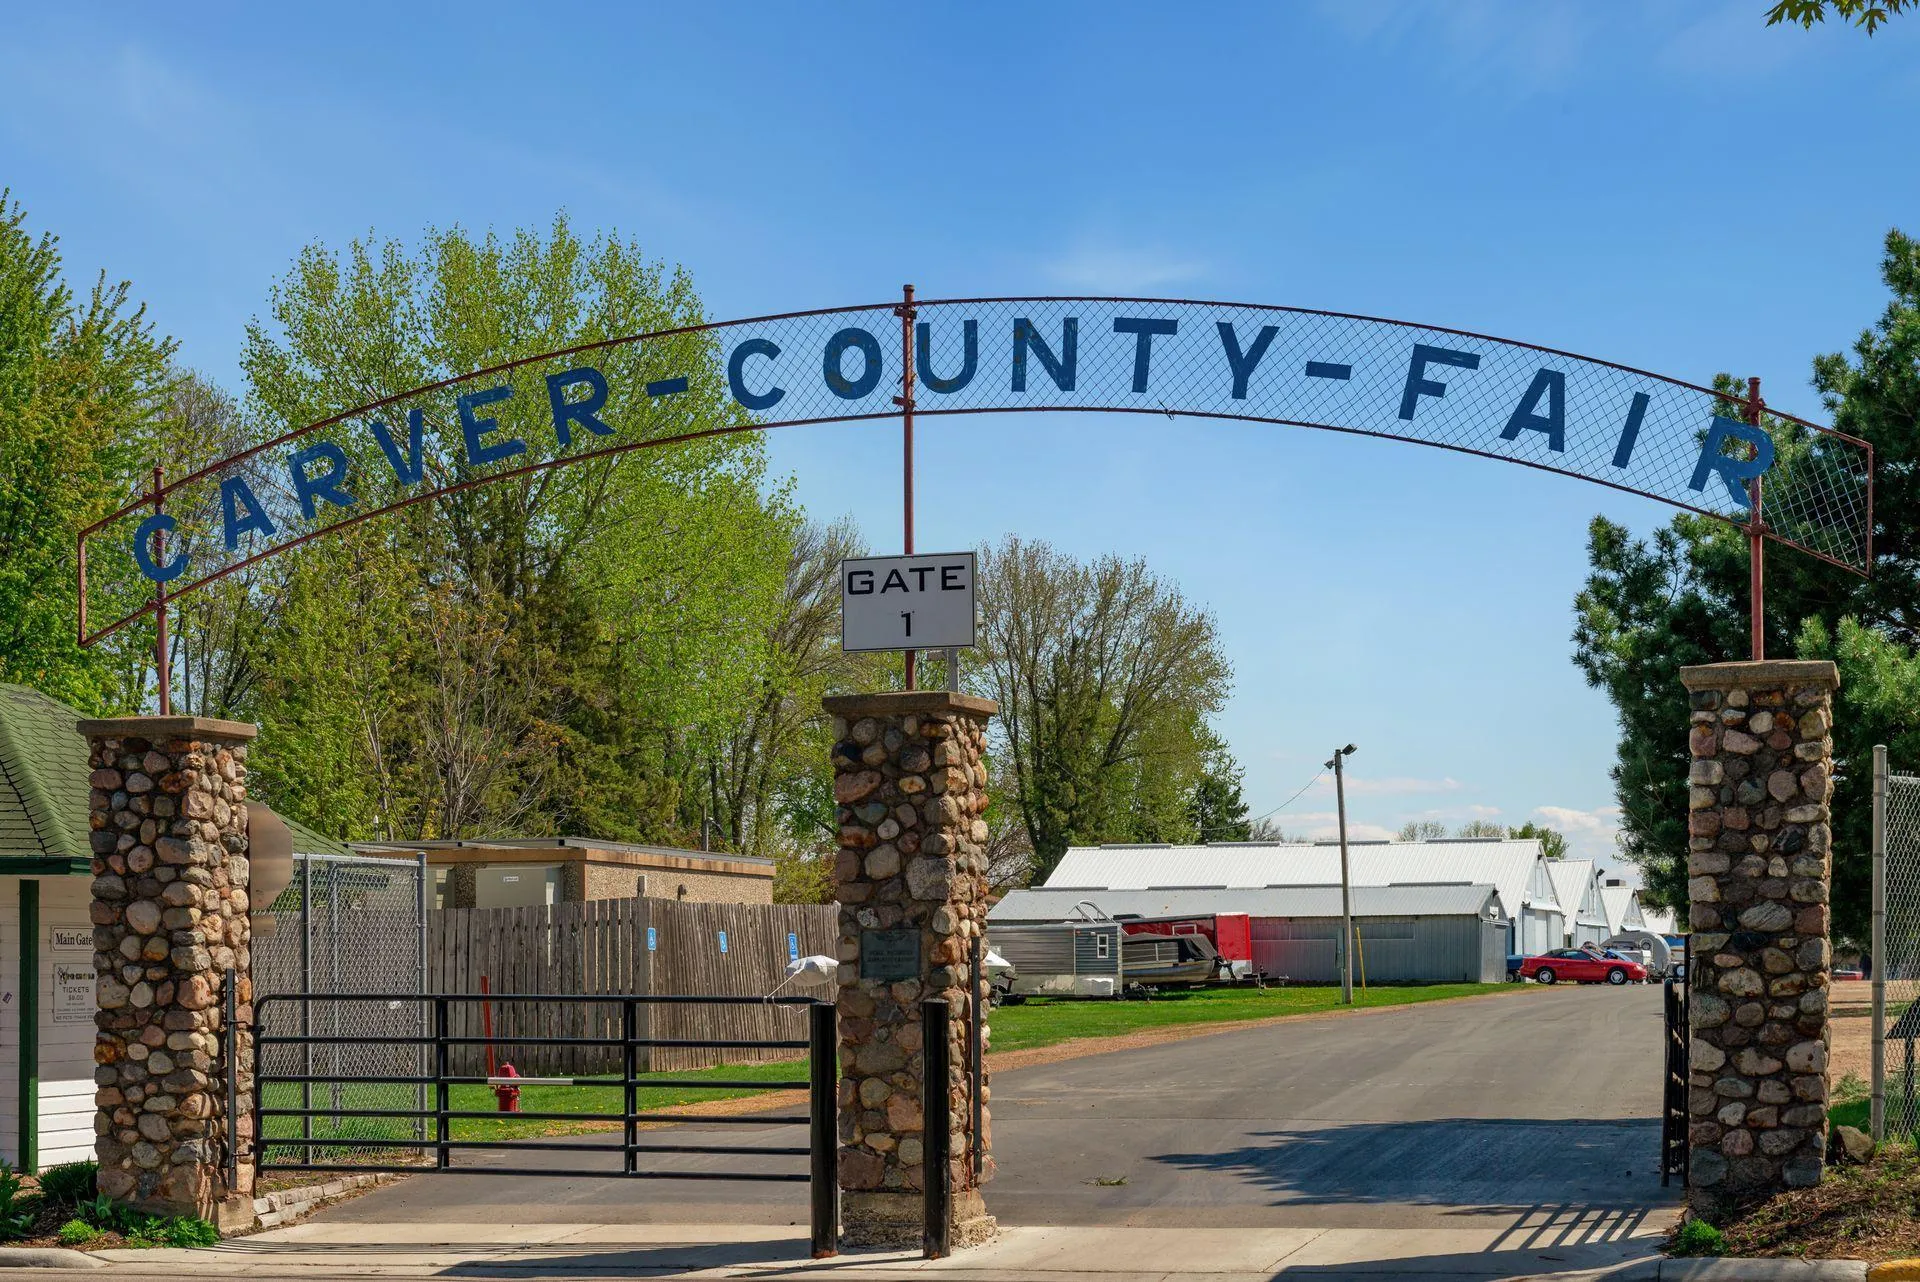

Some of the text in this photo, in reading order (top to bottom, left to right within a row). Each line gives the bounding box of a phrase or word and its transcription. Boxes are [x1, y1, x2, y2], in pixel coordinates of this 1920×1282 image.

[847, 565, 966, 596] GATE
[900, 611, 912, 638] 1
[55, 932, 93, 946] Main Gate
[62, 986, 90, 994] TICKETS
